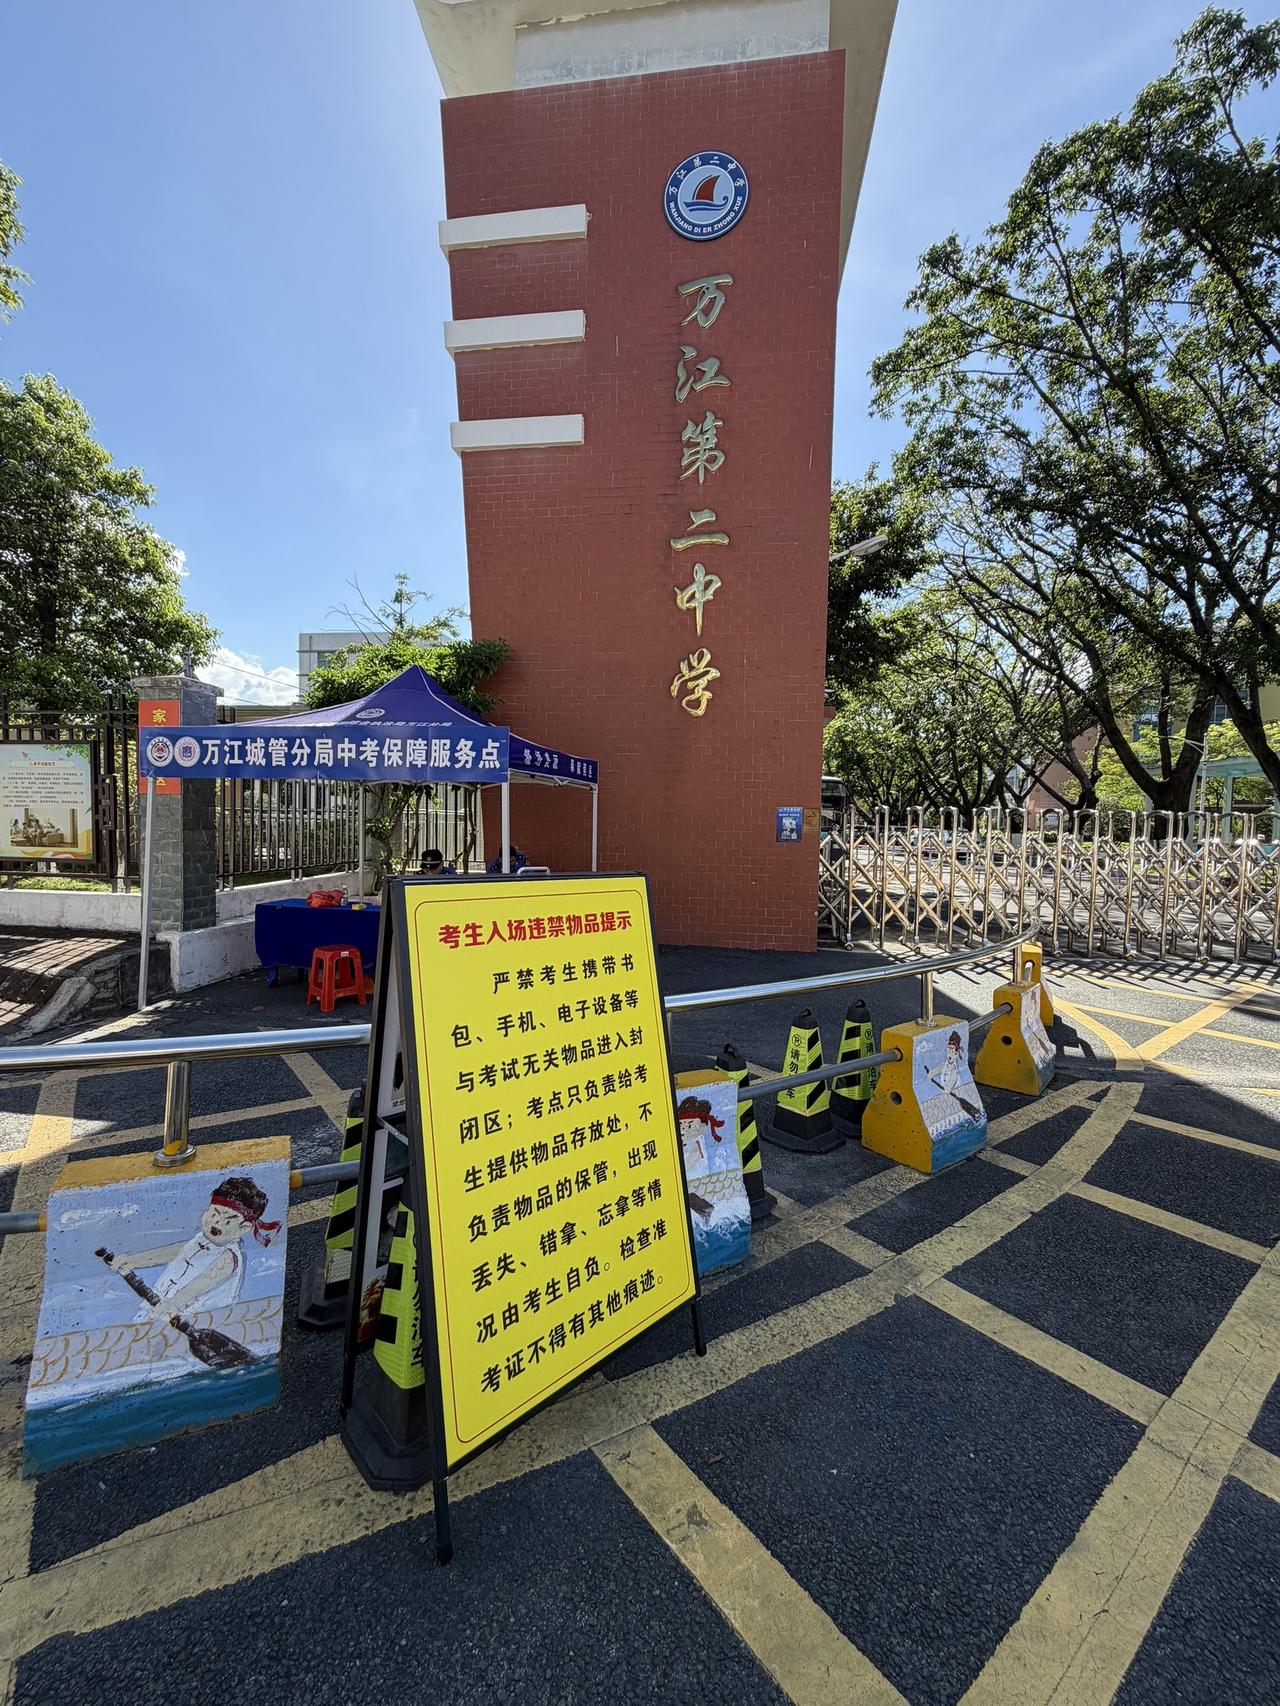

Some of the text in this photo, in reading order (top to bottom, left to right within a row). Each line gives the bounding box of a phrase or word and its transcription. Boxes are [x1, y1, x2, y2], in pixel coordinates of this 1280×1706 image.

[669, 156, 745, 195] 万江第二中学
[669, 201, 693, 231] WANJIANG
[713, 212, 736, 231] ZHONG
[733, 196, 743, 211] XUE
[670, 273, 734, 718] 万江第二中学
[202, 737, 501, 769] 万江城管分局中考保障服务点
[438, 910, 633, 949] 考生入场违禁物品提示
[492, 953, 635, 994] 严禁考生携带书
[451, 989, 639, 1048] 包、手机、电子设备等
[455, 1026, 644, 1093] 与考试无关物品进入封
[786, 1048, 800, 1099] 请勿车
[459, 1064, 648, 1144] 闭区；考点只负责给考
[463, 1102, 653, 1193] 生提供物品存放处，不
[467, 1140, 658, 1243] 负责物品的保管，出现
[471, 1178, 662, 1293] 丢失、错拿、忘拿等情
[476, 1218, 668, 1343] 况由考生自负。检查准
[480, 1269, 664, 1393] 考证不得有其他痕迹。
